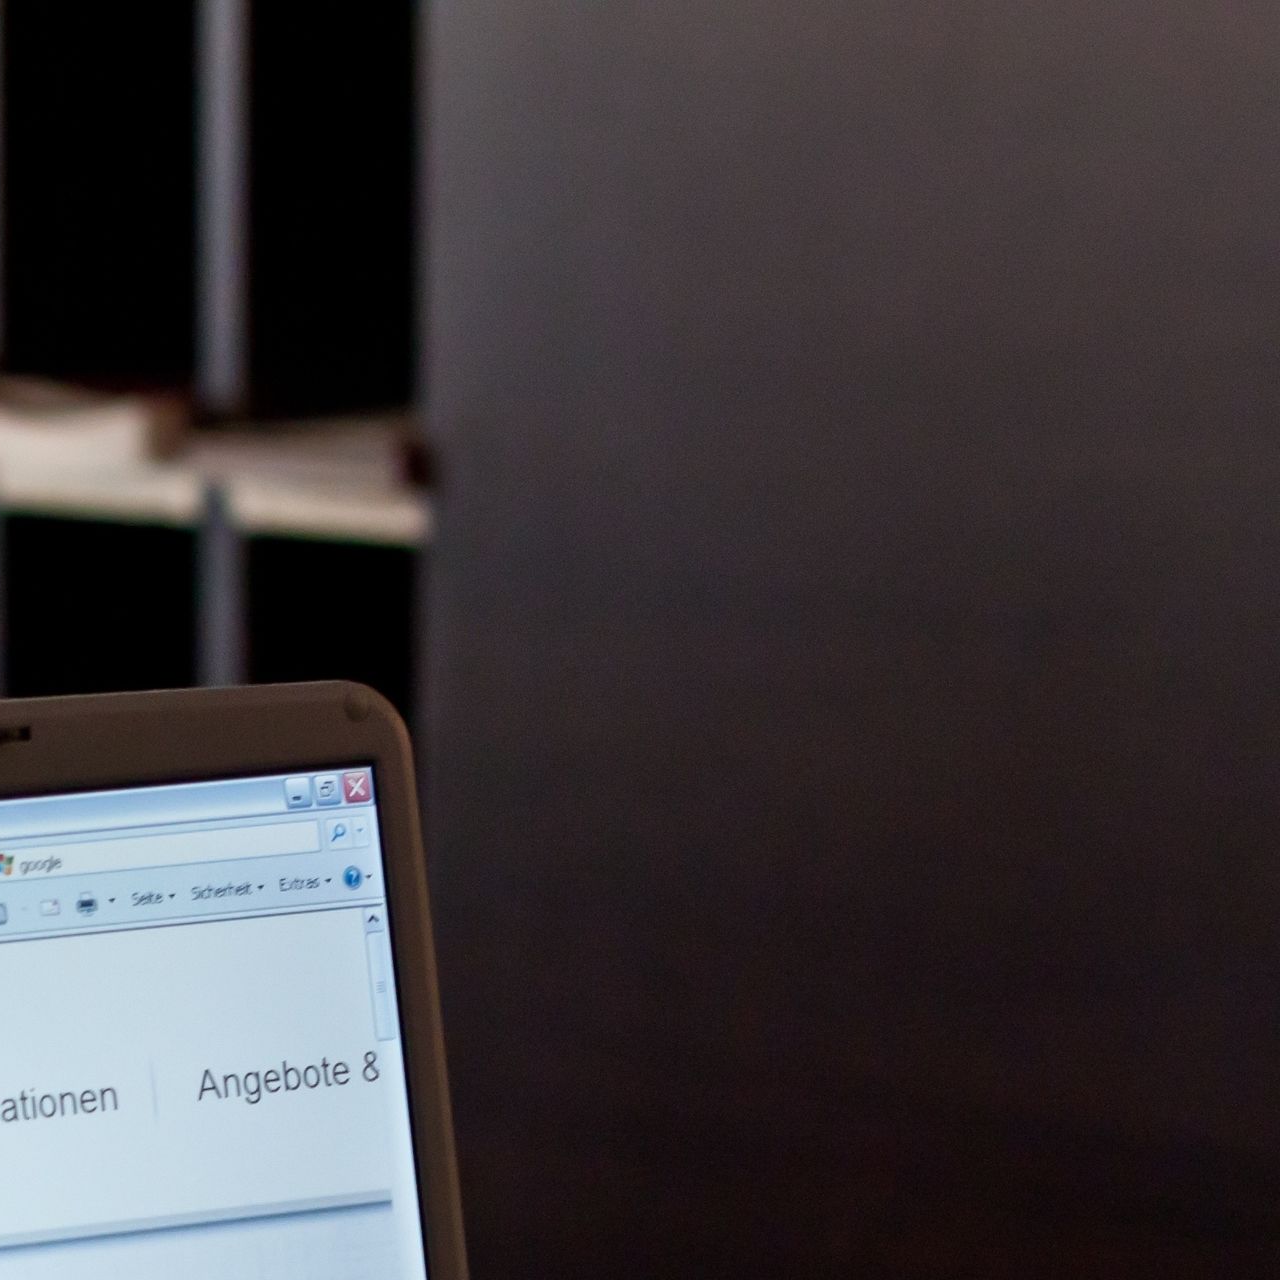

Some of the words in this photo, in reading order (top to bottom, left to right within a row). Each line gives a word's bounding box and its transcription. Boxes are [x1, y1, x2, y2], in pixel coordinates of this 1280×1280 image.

[19, 854, 63, 876] google
[190, 879, 253, 902] Sicherheit
[278, 873, 322, 893] Extras
[131, 888, 165, 907] Seite
[197, 1055, 351, 1106] Angebote
[361, 1050, 382, 1084] &
